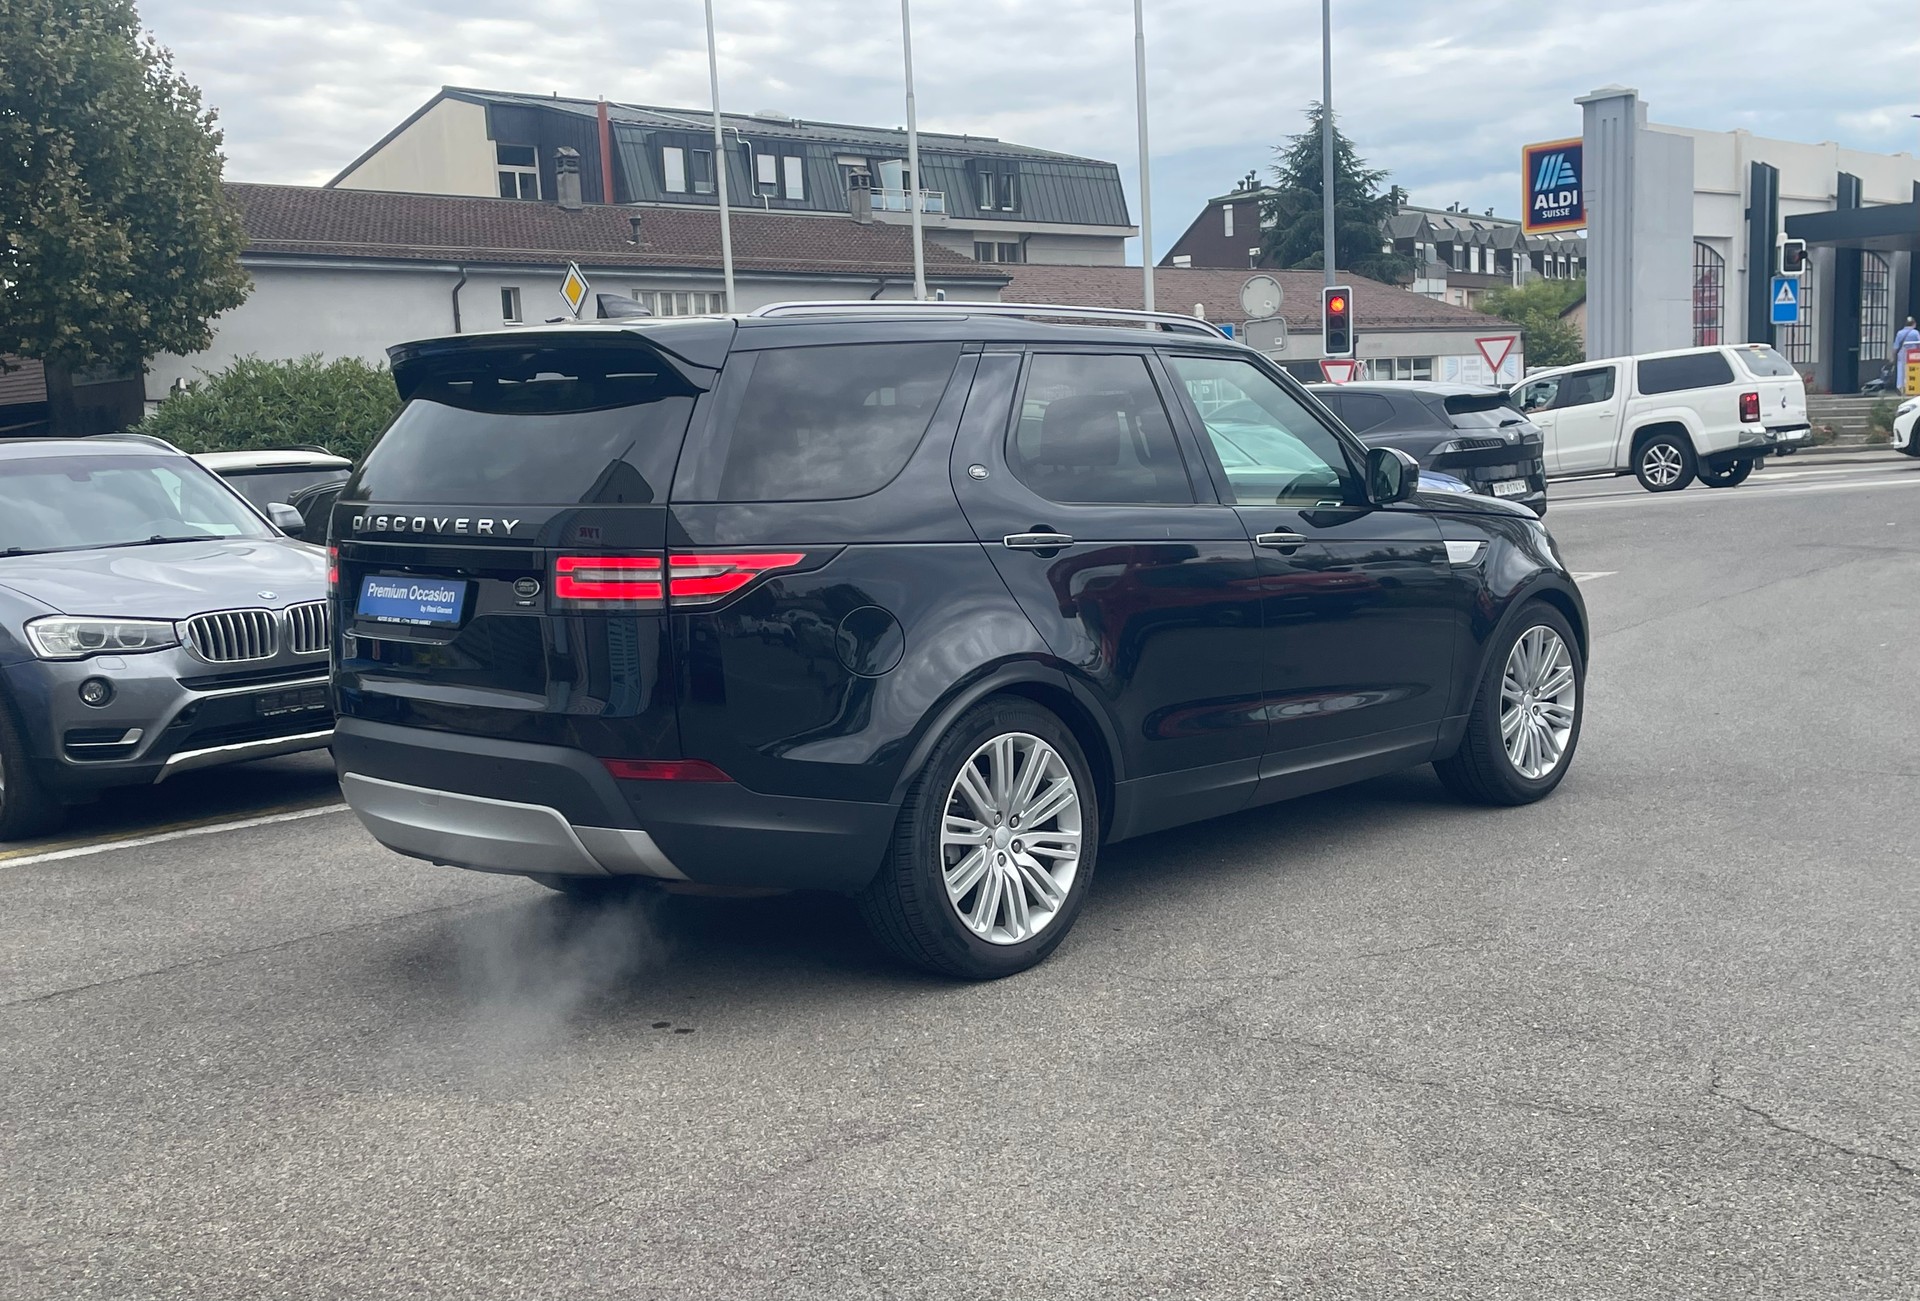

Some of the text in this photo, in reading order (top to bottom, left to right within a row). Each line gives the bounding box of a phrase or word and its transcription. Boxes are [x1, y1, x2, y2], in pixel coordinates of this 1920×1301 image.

[1534, 189, 1578, 210] ALDI
[1542, 208, 1571, 219] SUISSE
[352, 515, 520, 535] DISCOVERY
[367, 583, 455, 602] Premium Occasion
